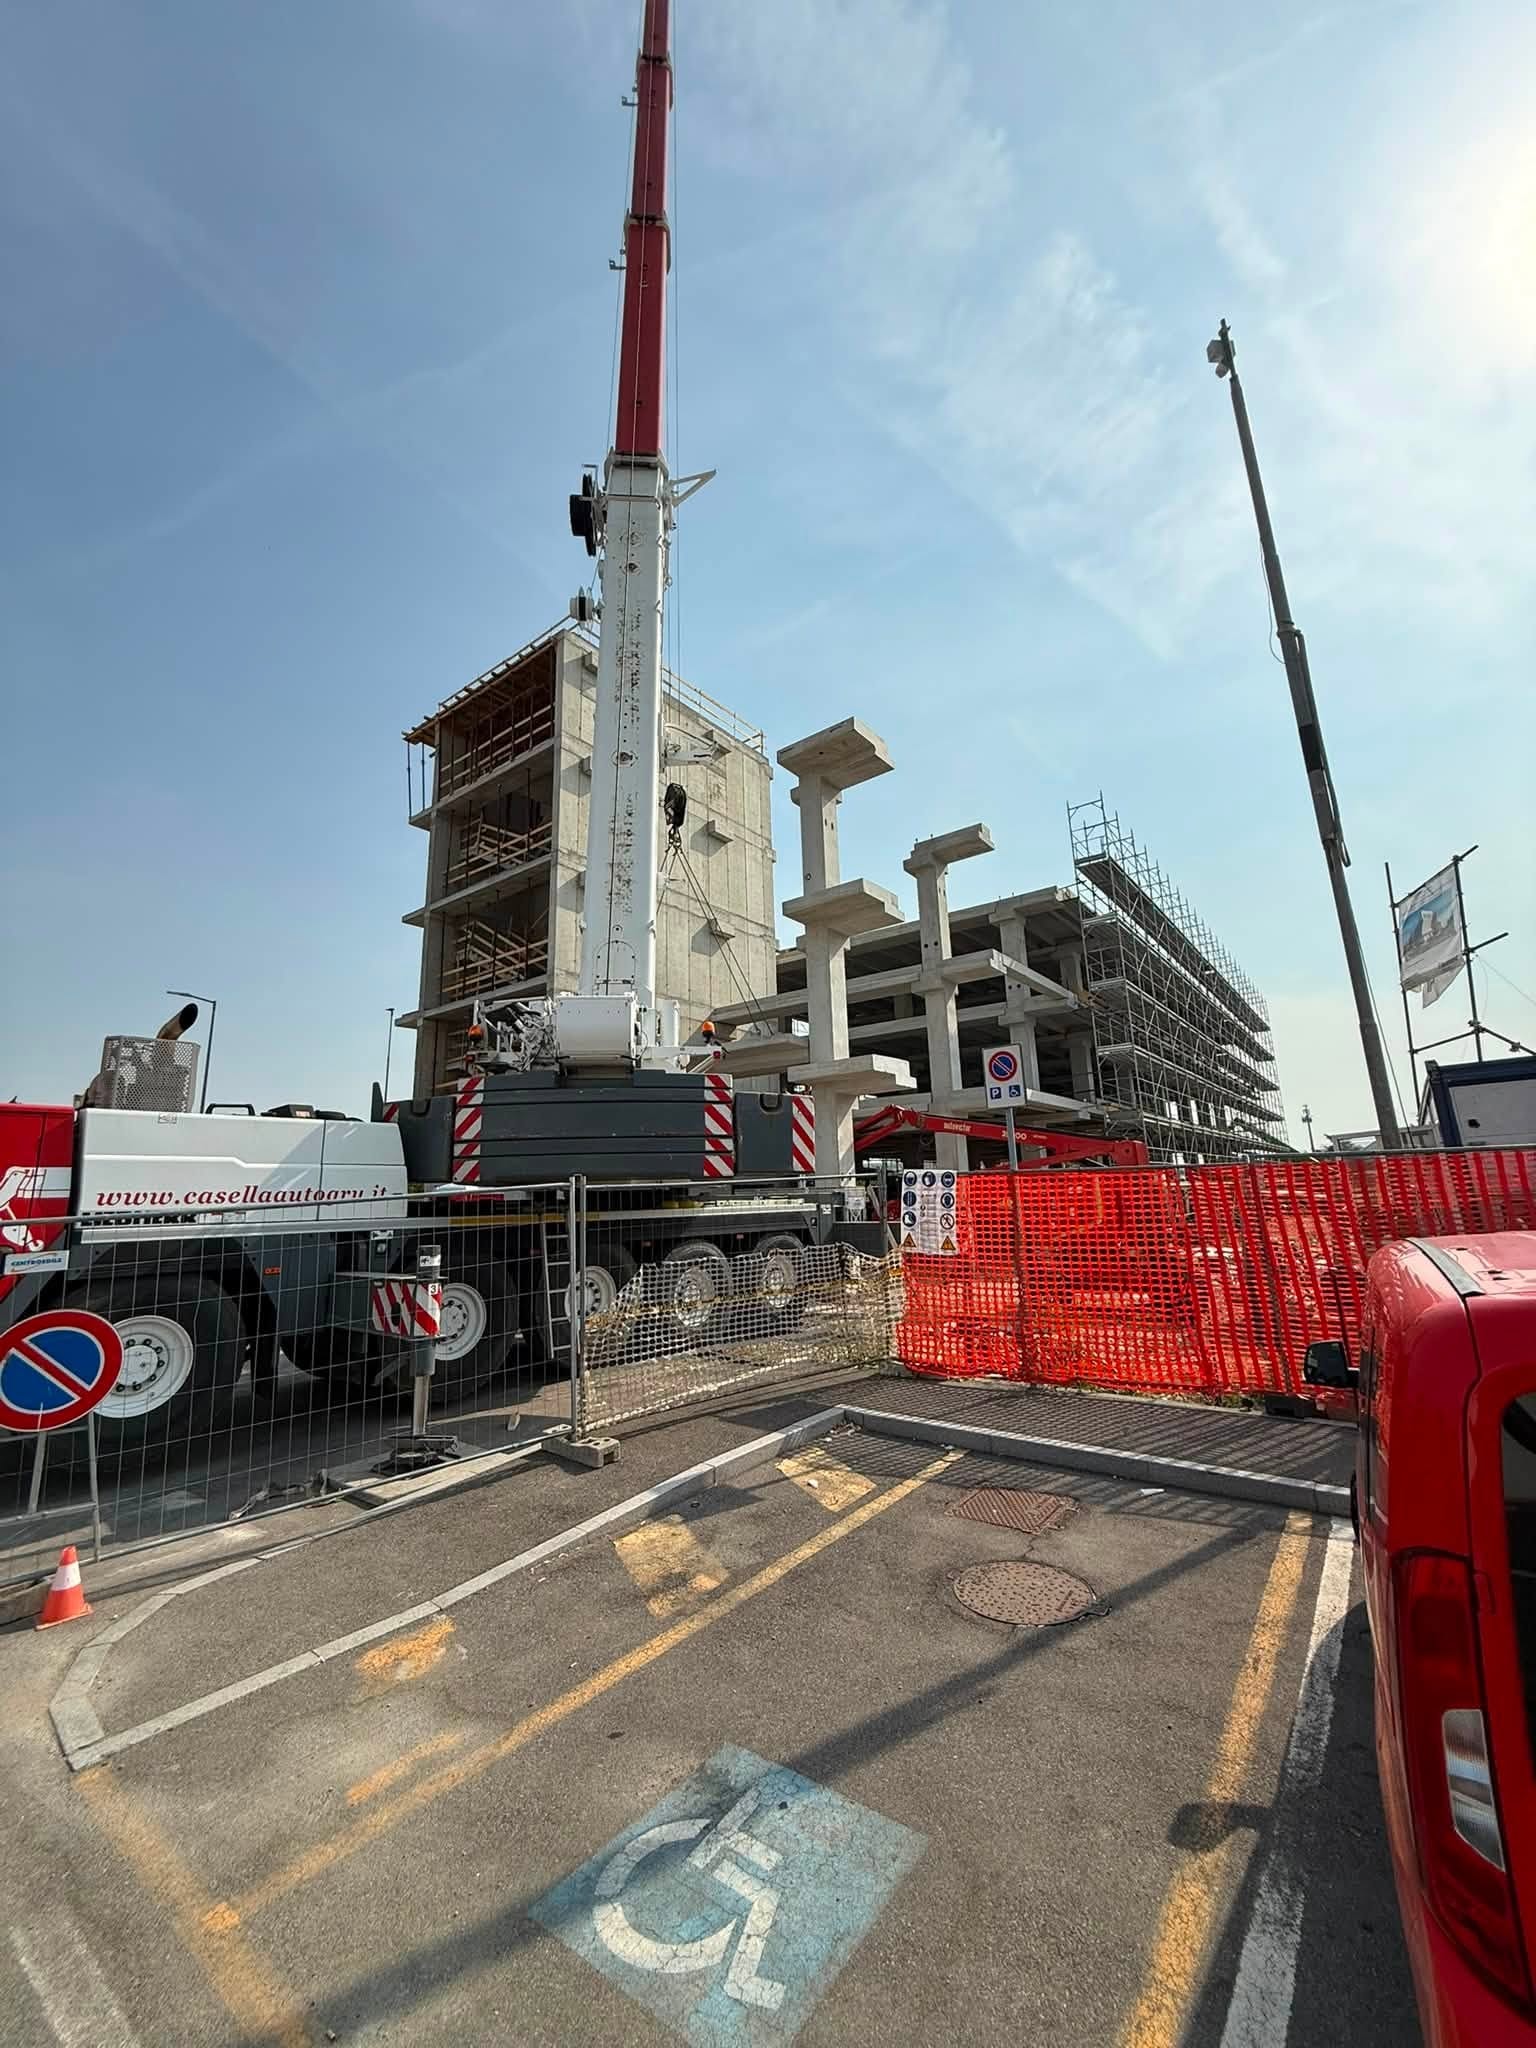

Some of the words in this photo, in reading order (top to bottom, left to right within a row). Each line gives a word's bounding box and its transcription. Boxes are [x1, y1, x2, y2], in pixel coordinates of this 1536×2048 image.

[992, 1088, 1000, 1099] P
[97, 1184, 388, 1206] www.casellaautogruit
[430, 1284, 437, 1294] 3
